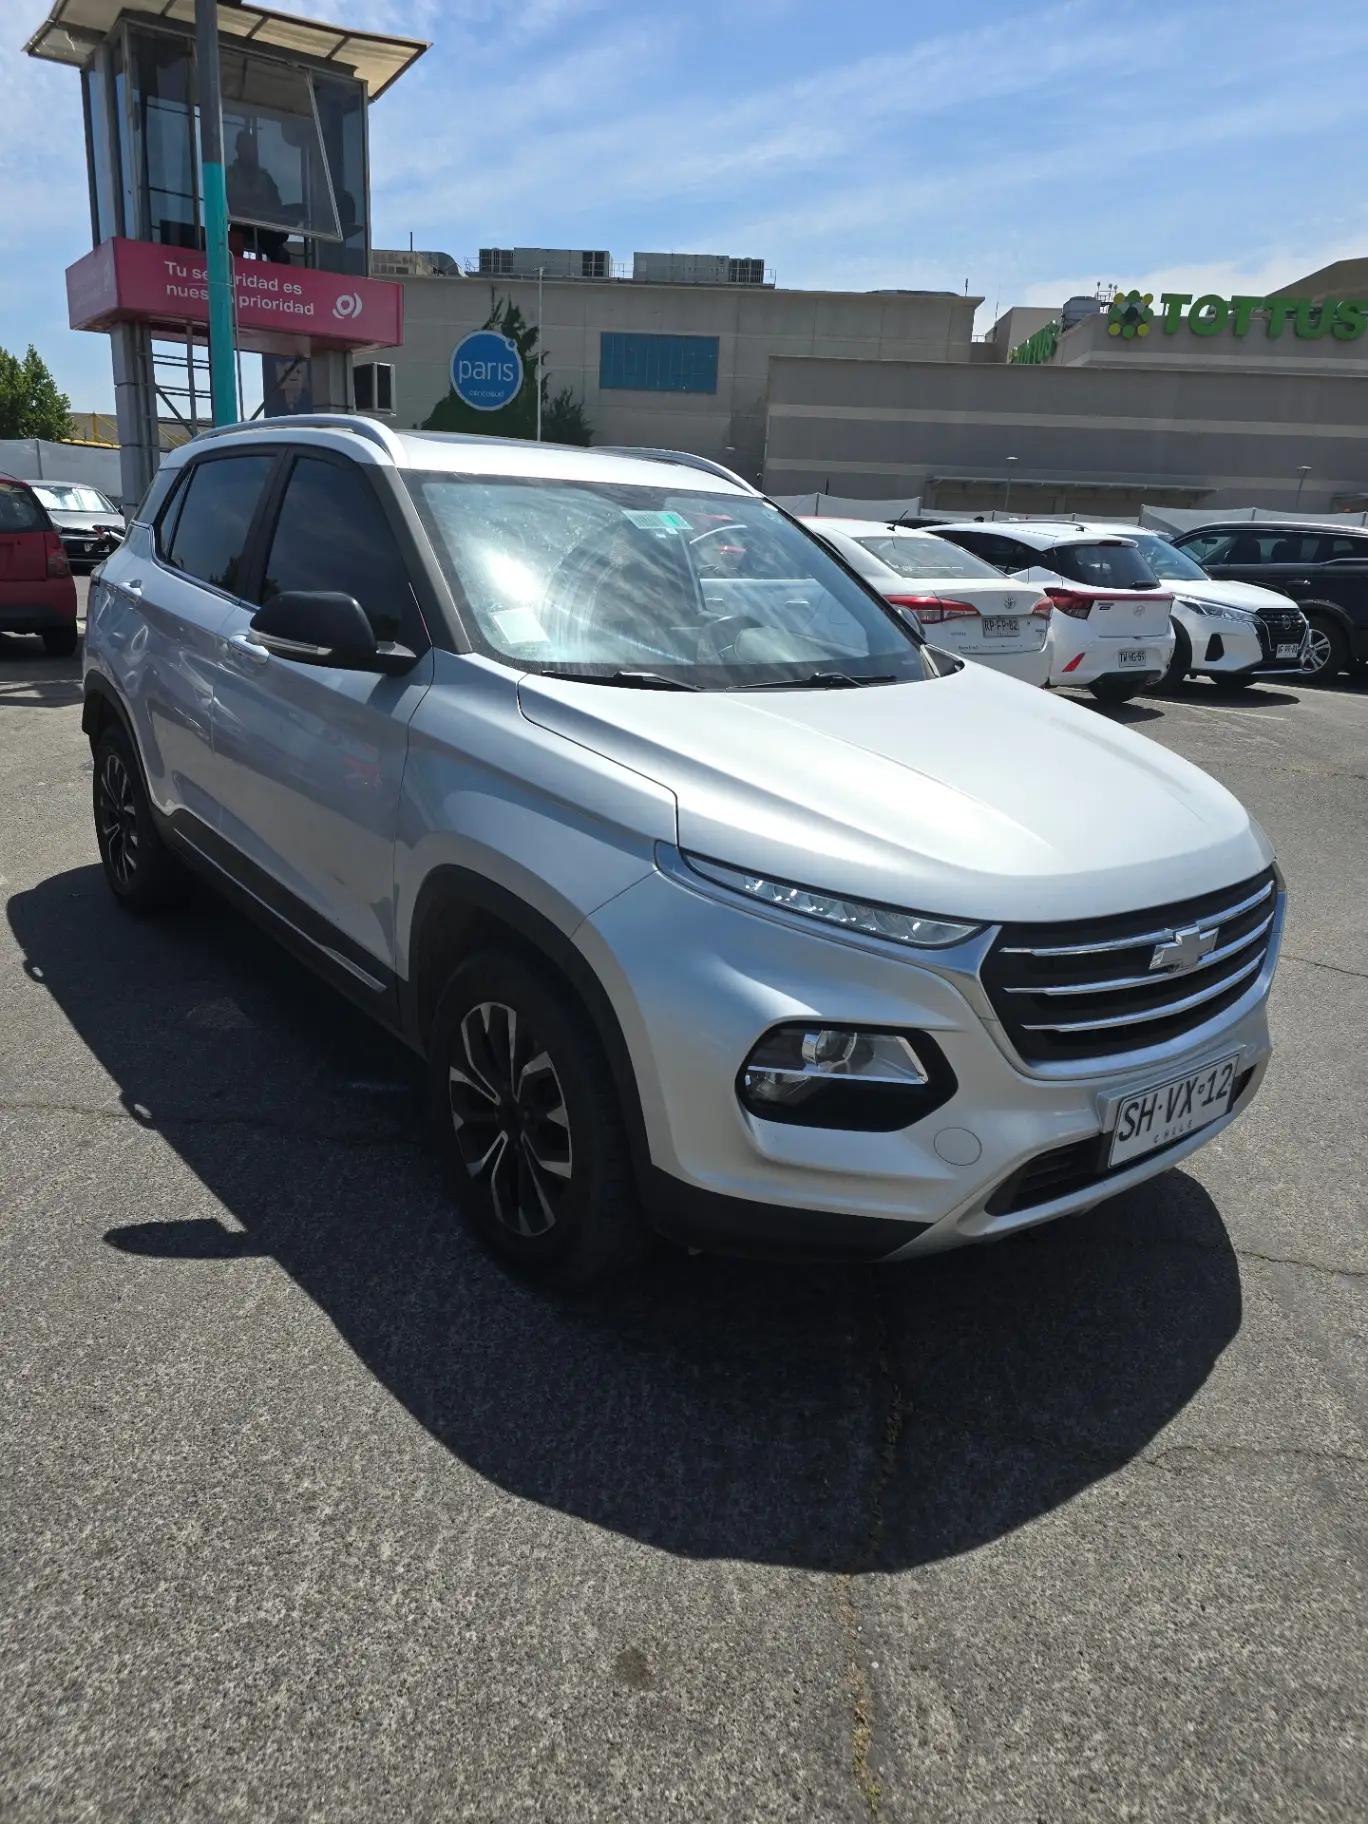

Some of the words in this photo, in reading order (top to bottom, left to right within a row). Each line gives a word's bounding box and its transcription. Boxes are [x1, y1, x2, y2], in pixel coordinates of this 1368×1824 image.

[164, 261, 187, 277] Tu
[192, 269, 279, 292] seridad
[283, 284, 302, 295] es
[239, 295, 314, 315] prioridad
[1161, 293, 1367, 341] TOTTUS
[459, 360, 514, 384] paris
